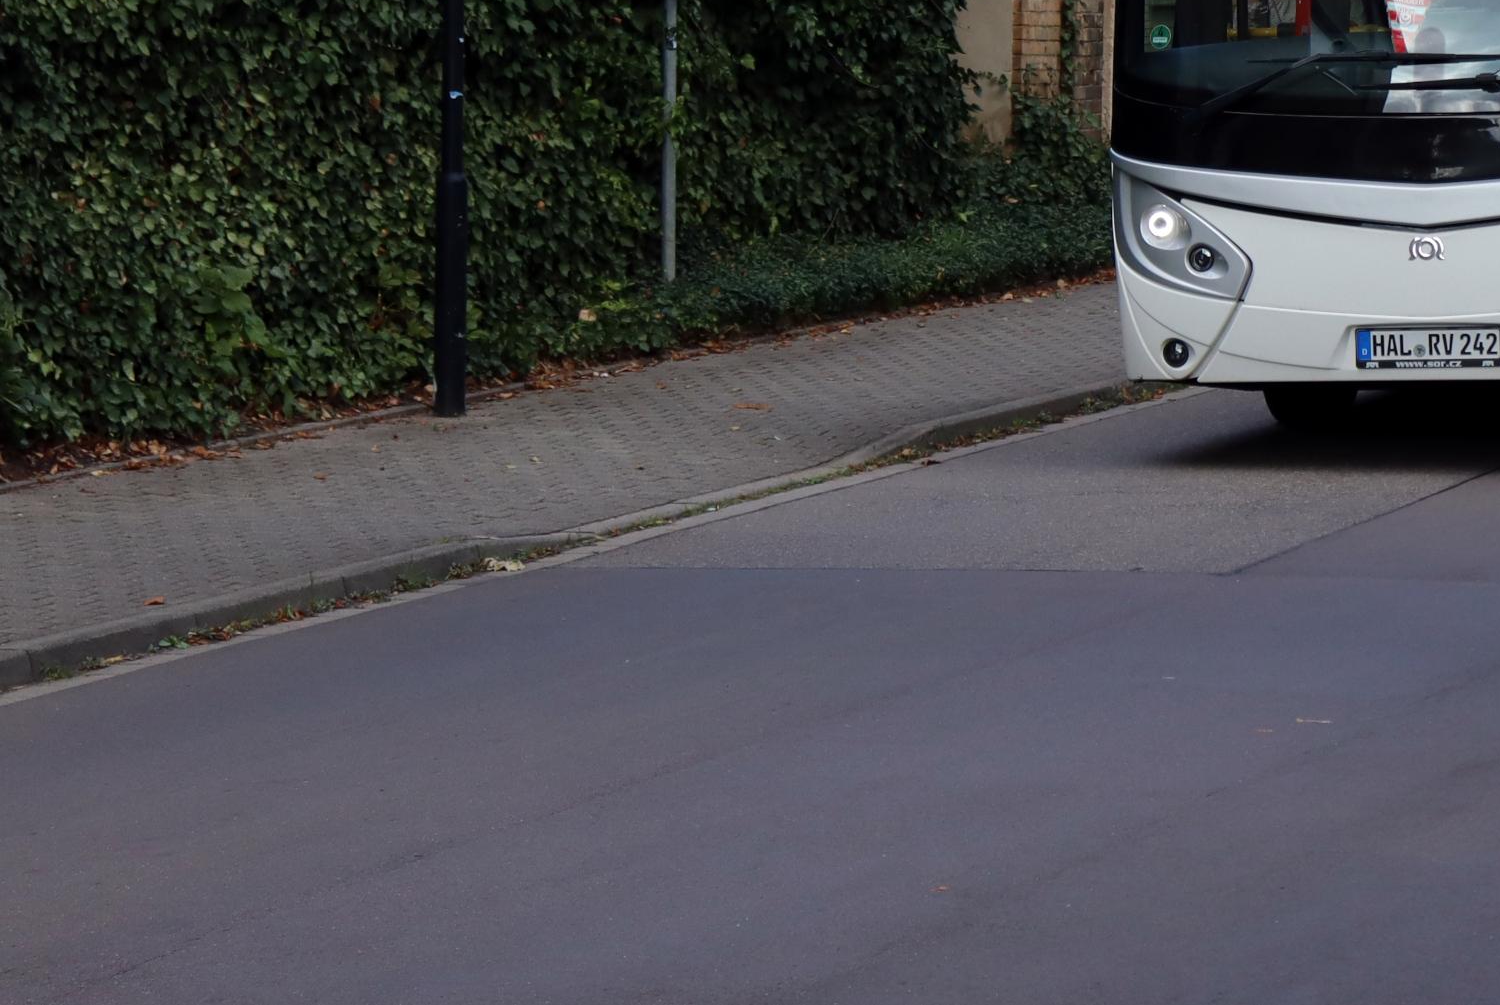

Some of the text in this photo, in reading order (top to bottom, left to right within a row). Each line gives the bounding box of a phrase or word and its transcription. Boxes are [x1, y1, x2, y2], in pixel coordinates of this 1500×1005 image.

[1372, 332, 1498, 357] HAL RV 242
[1361, 348, 1368, 356] D
[1395, 360, 1463, 368] www.sor.cz
